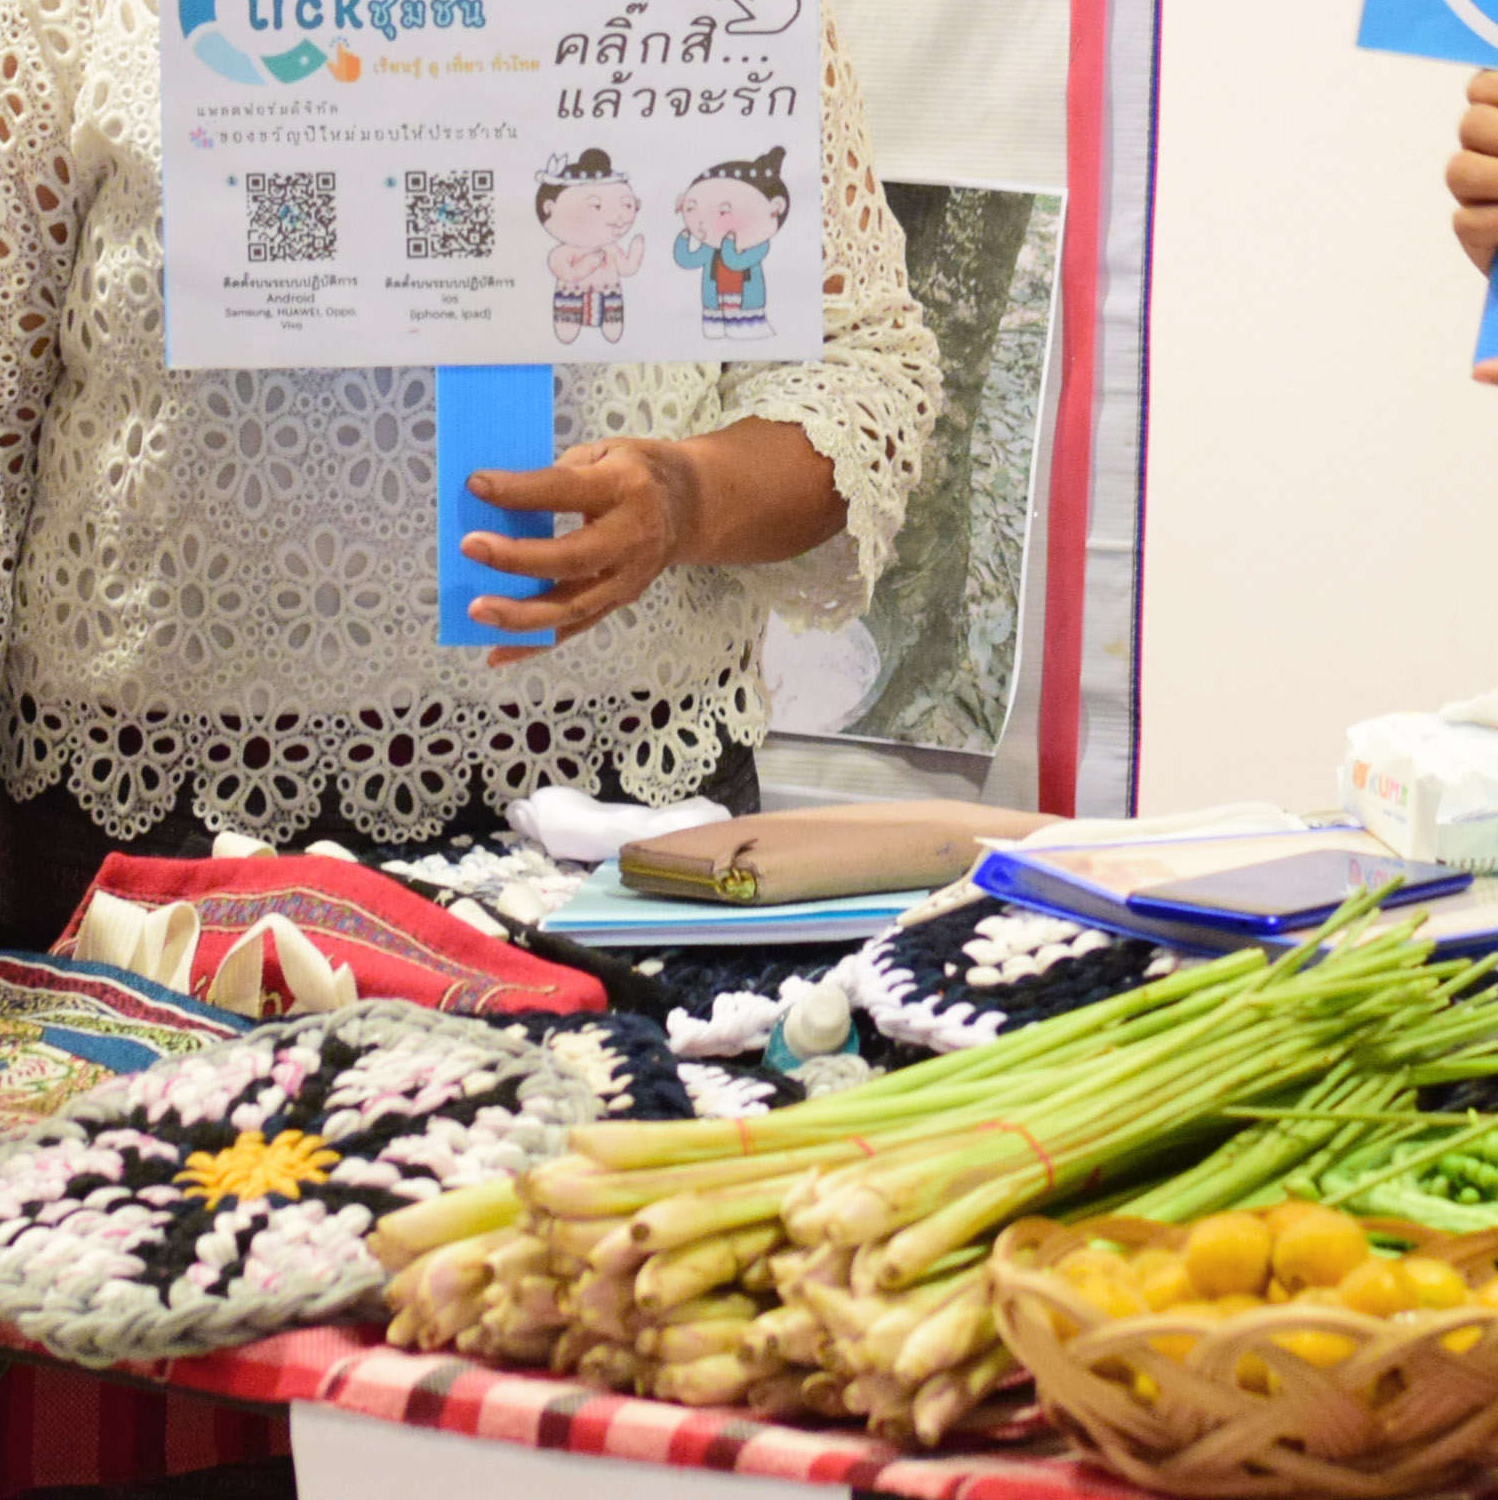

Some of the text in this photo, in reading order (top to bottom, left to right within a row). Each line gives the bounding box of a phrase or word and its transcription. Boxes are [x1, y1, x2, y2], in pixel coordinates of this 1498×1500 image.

[557, 70, 797, 119] แล้วจะรัก
[219, 121, 519, 147] ของขวัญปีใหม่มอบให้ประชาชน
[266, 293, 315, 304] Android
